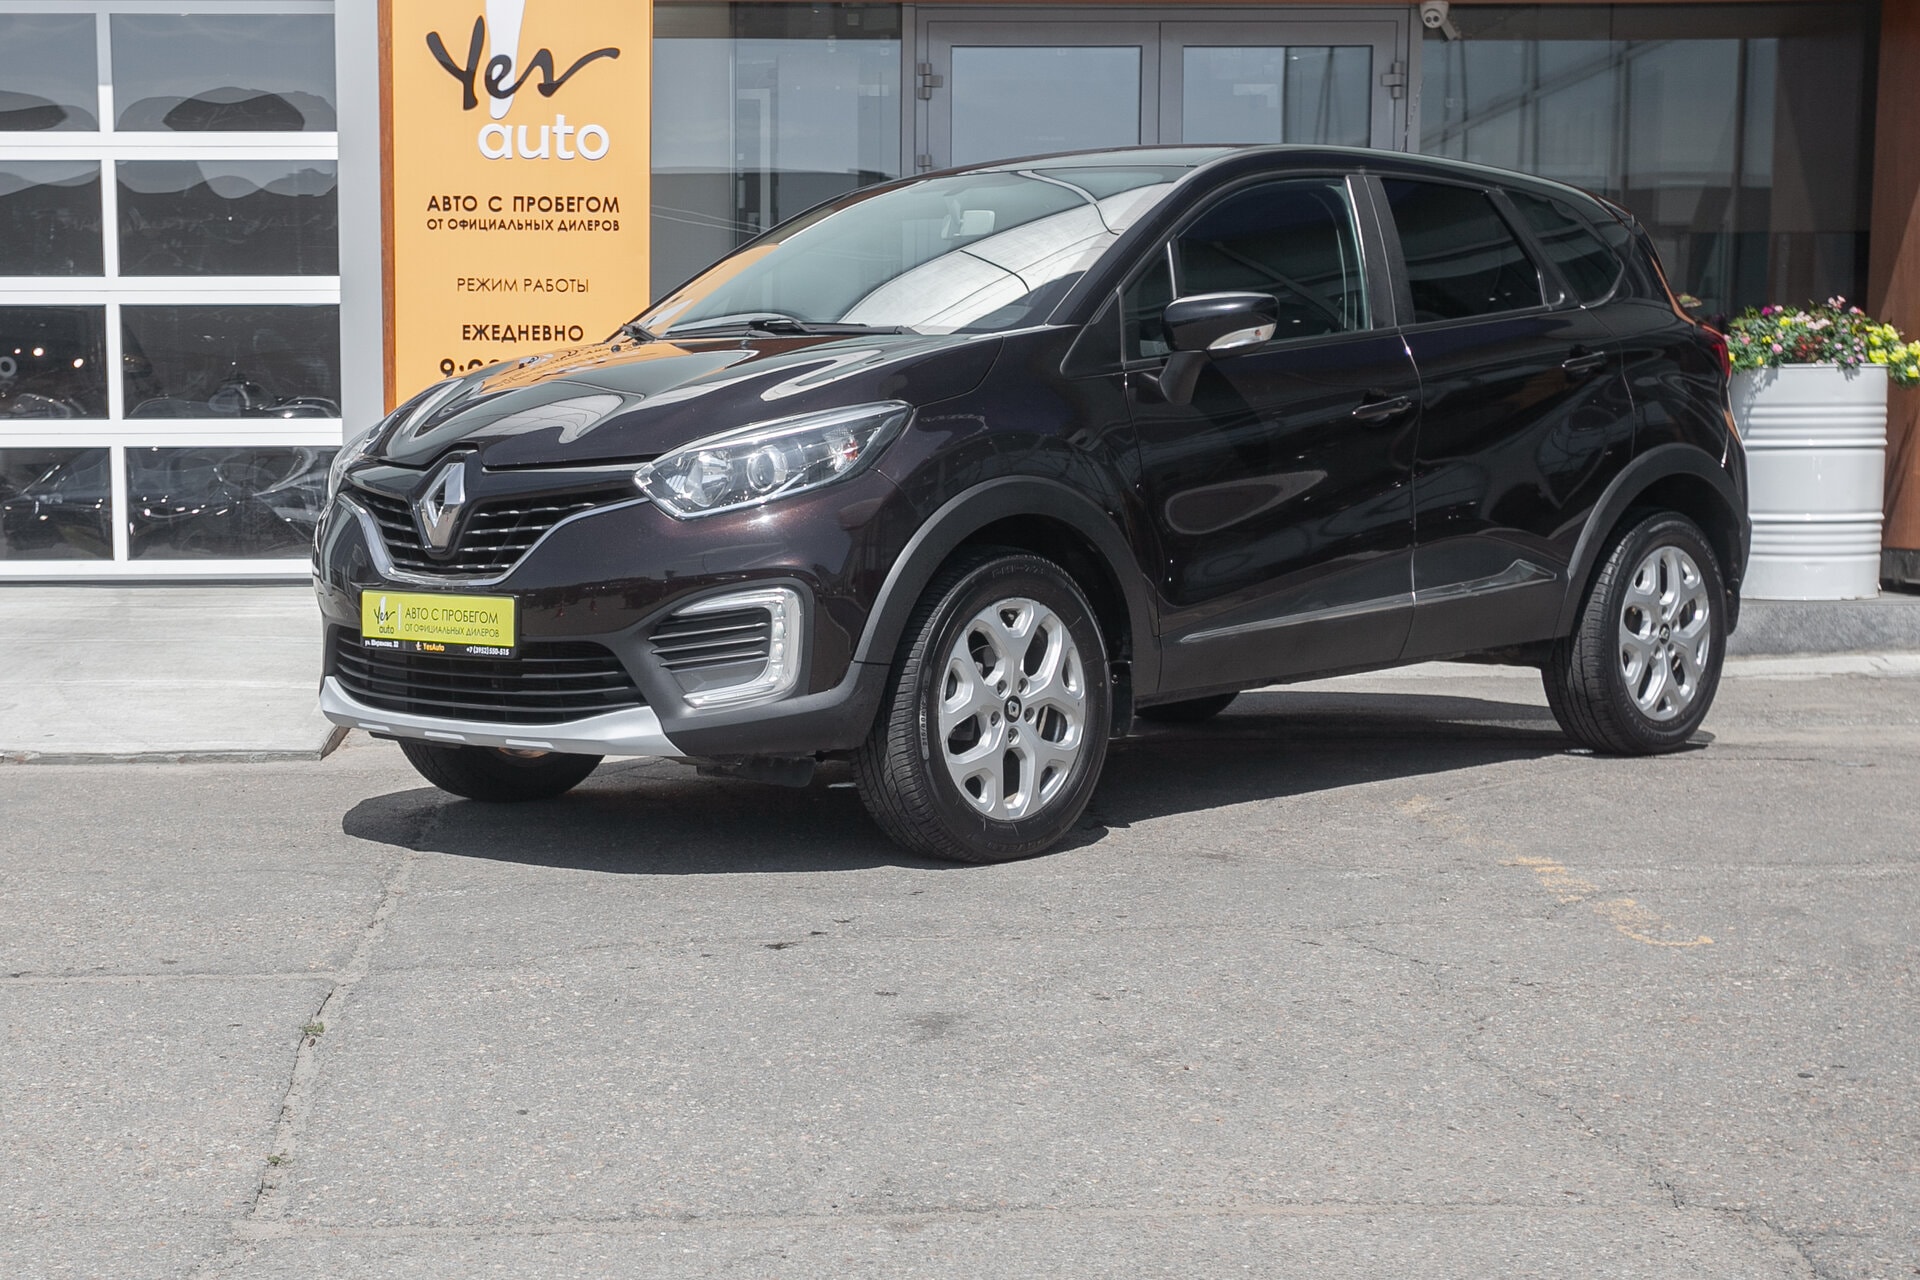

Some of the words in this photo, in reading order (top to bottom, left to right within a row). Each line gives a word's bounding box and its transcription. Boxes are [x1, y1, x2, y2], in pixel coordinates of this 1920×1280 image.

[426, 15, 621, 110] Yes
[477, 113, 610, 160] auto
[427, 195, 478, 213] АВТО
[487, 195, 503, 213] С
[512, 196, 620, 213] ПРОБЕГОМ
[426, 218, 444, 231] ОТ
[447, 218, 554, 233] ОФИЦИАЛЬНЫХ
[557, 219, 620, 233] ДИЛЕРОВ
[456, 277, 518, 293] РЕЖИМ
[523, 278, 589, 293] РАБОТЫ
[462, 324, 584, 344] ЕЖЕДНЕВНО
[405, 607, 429, 621] АВТО
[431, 608, 440, 621] С
[441, 608, 499, 624] ПРОБЕГОМ
[379, 625, 395, 634] auto
[404, 623, 413, 632] ОТ
[466, 627, 500, 638] ДИЛЕРОВ
